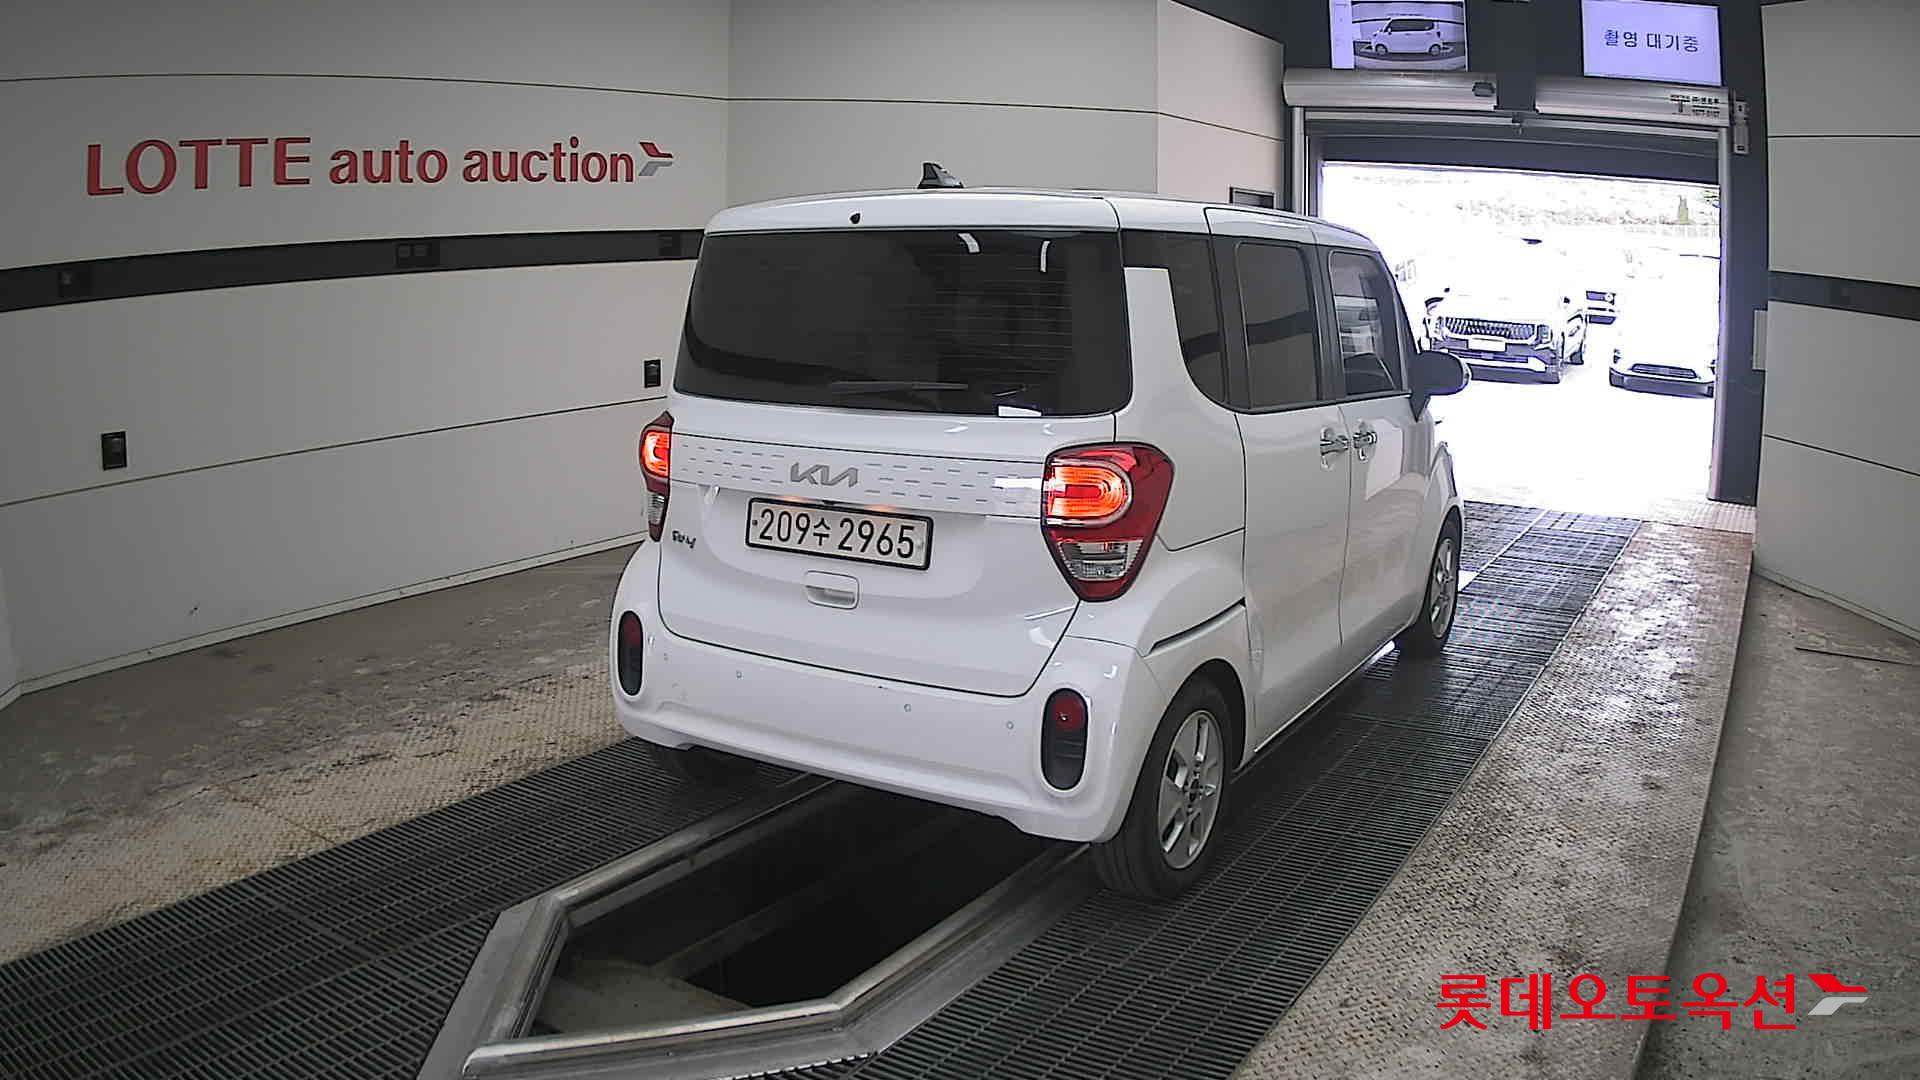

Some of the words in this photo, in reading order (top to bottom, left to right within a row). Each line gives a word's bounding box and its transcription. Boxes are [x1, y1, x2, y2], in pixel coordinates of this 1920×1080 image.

[1646, 33, 1698, 53] 대기중
[86, 136, 311, 196] LOTTE
[328, 139, 448, 184] auto
[462, 136, 634, 183] auction
